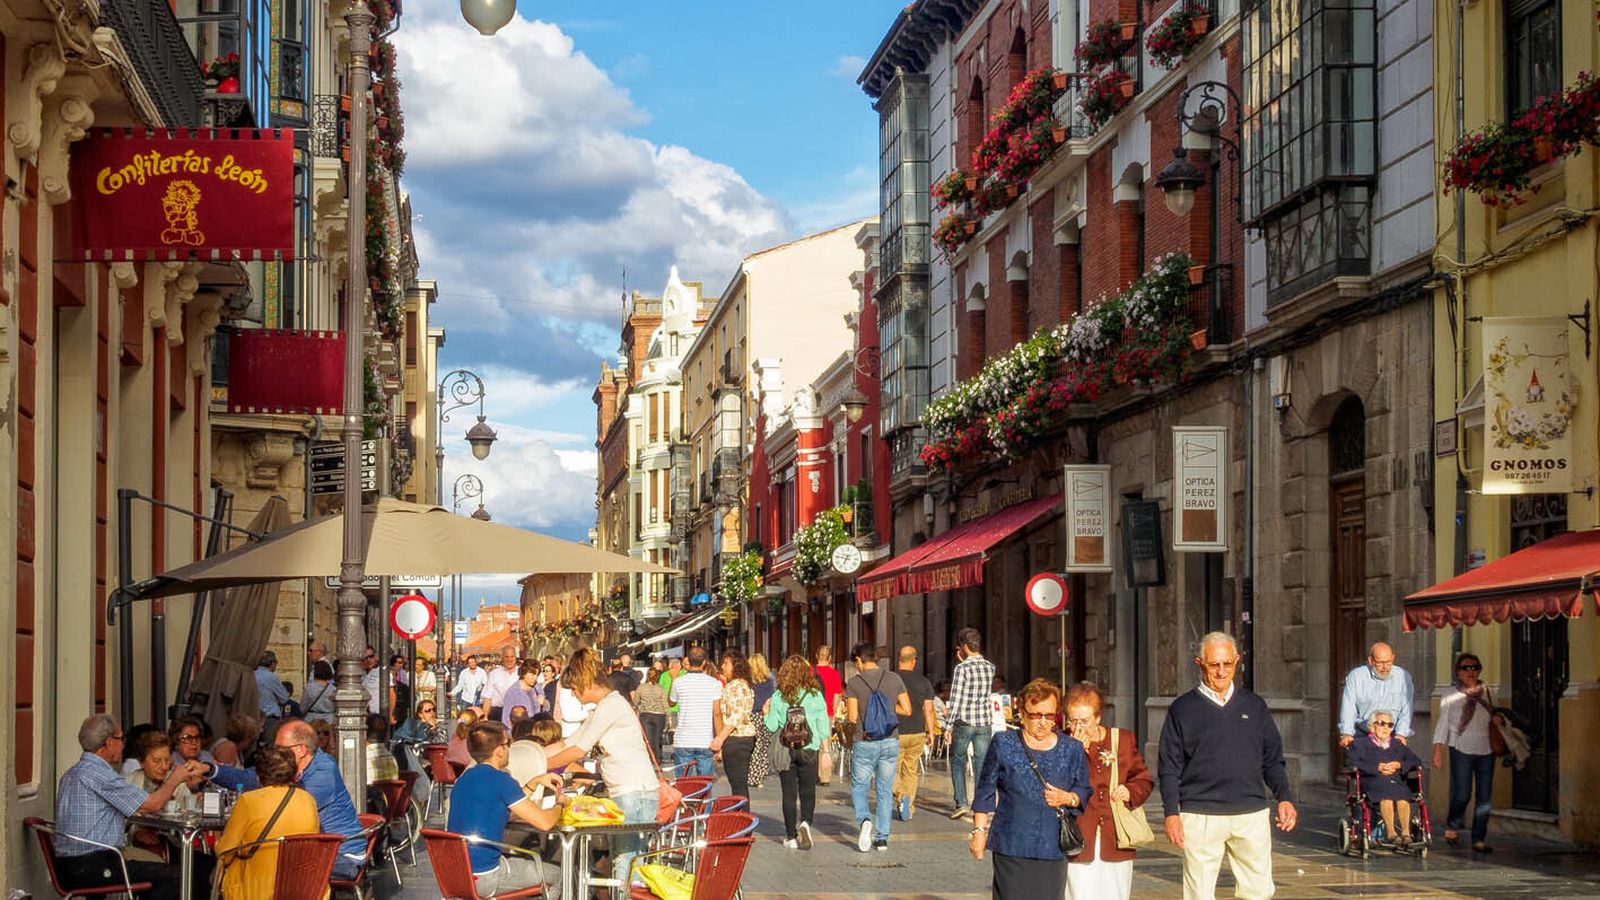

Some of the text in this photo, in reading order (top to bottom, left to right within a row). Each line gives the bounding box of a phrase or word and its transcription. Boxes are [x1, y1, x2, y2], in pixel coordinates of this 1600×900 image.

[96, 149, 211, 195] Confiterías
[1490, 458, 1567, 471] GNOMOS
[1185, 477, 1215, 486] OPTICA
[1185, 488, 1215, 497] PEREZ
[1185, 499, 1215, 508] BRAVO
[1075, 509, 1102, 517] OPTICA
[1076, 518, 1102, 526] PEREZ
[1076, 527, 1103, 535] BRAVO
